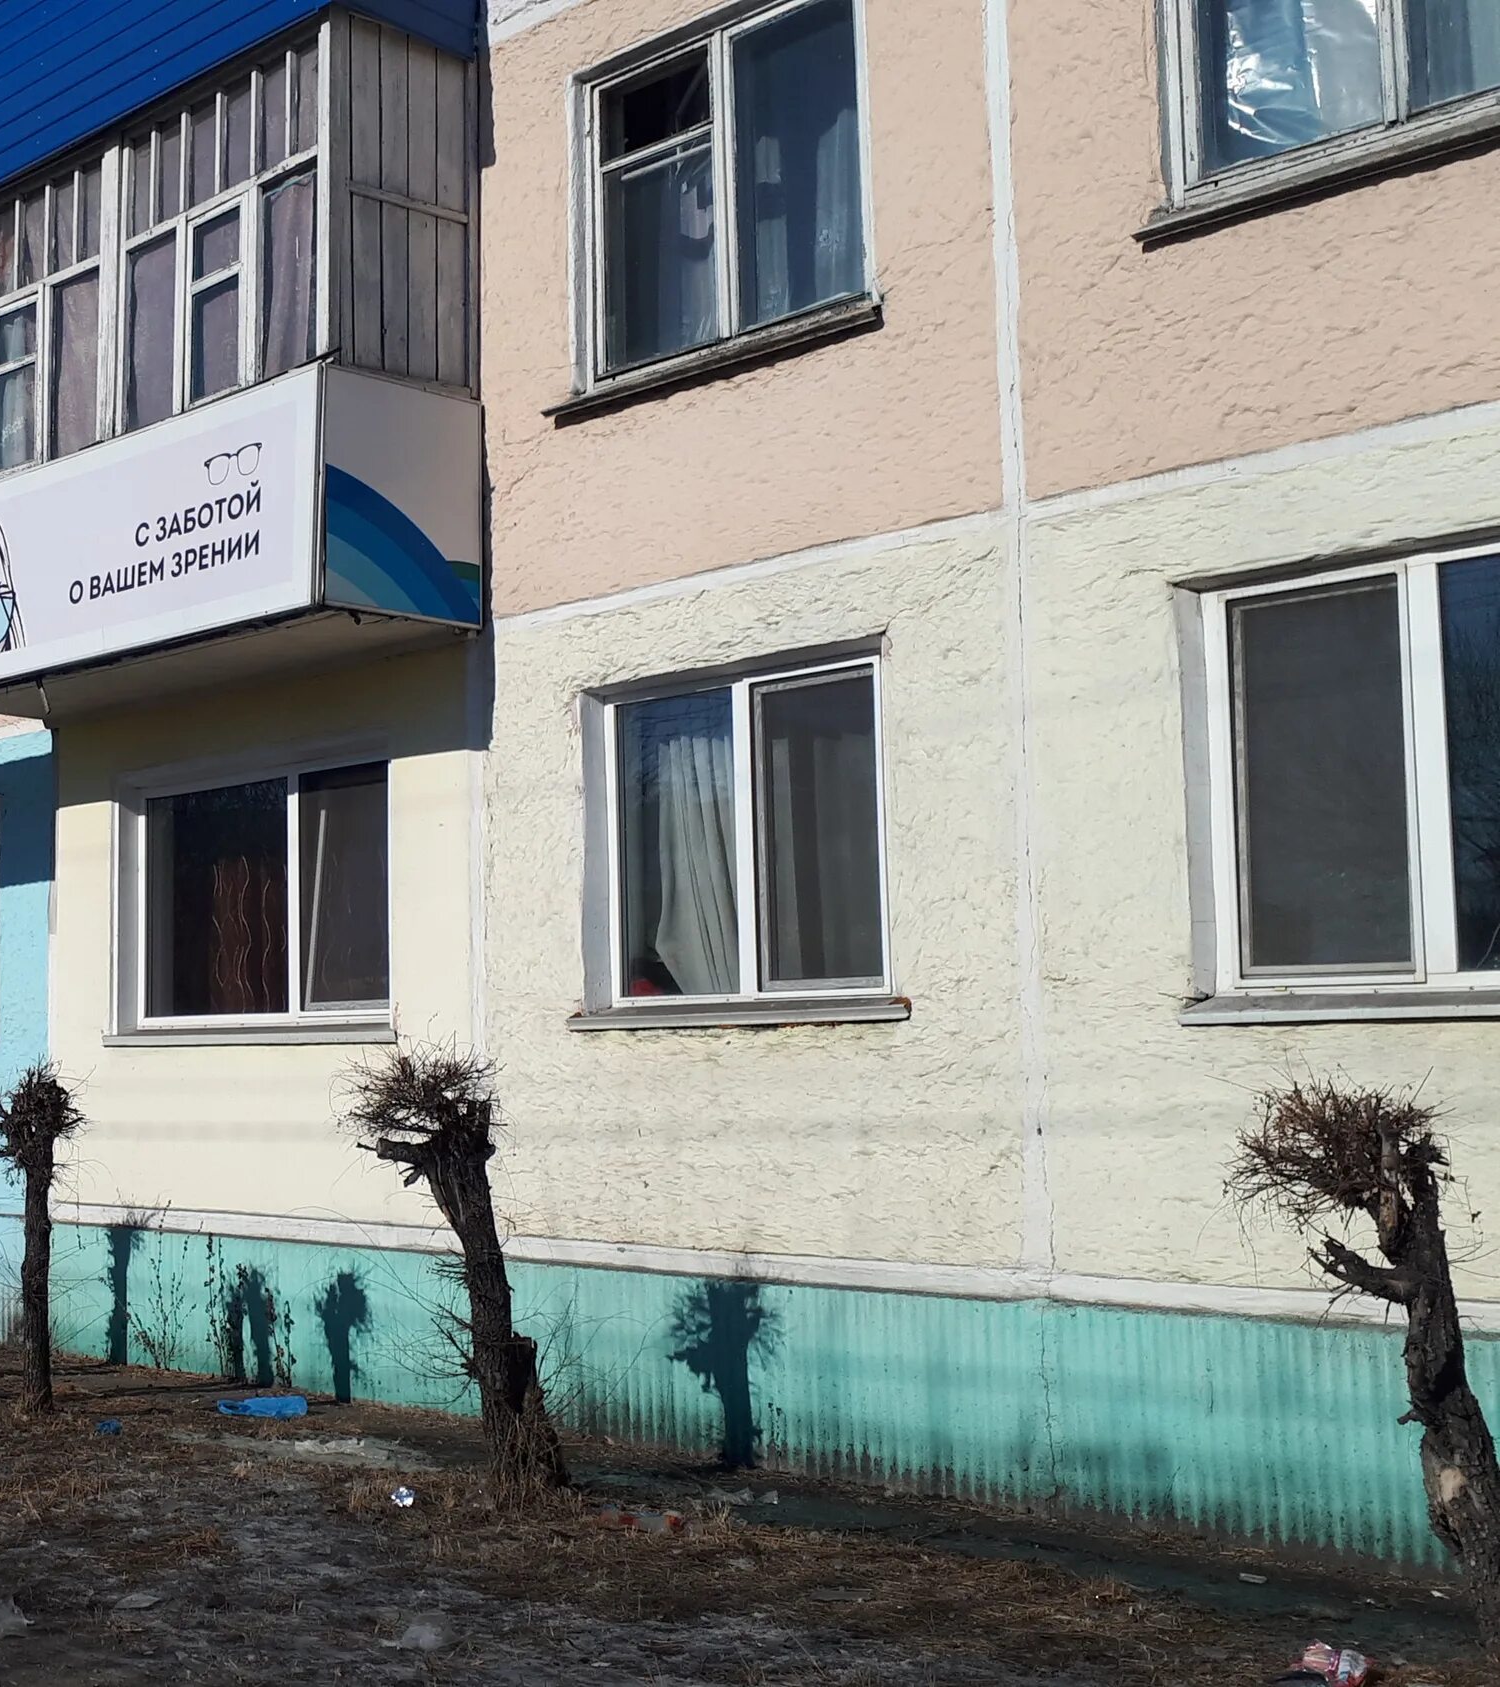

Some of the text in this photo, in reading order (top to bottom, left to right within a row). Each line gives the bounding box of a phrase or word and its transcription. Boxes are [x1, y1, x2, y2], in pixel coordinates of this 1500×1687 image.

[135, 479, 261, 547] С ЗАБОТОЙ
[69, 529, 260, 604] О ВАШЕМ ЗРЕНИИ
